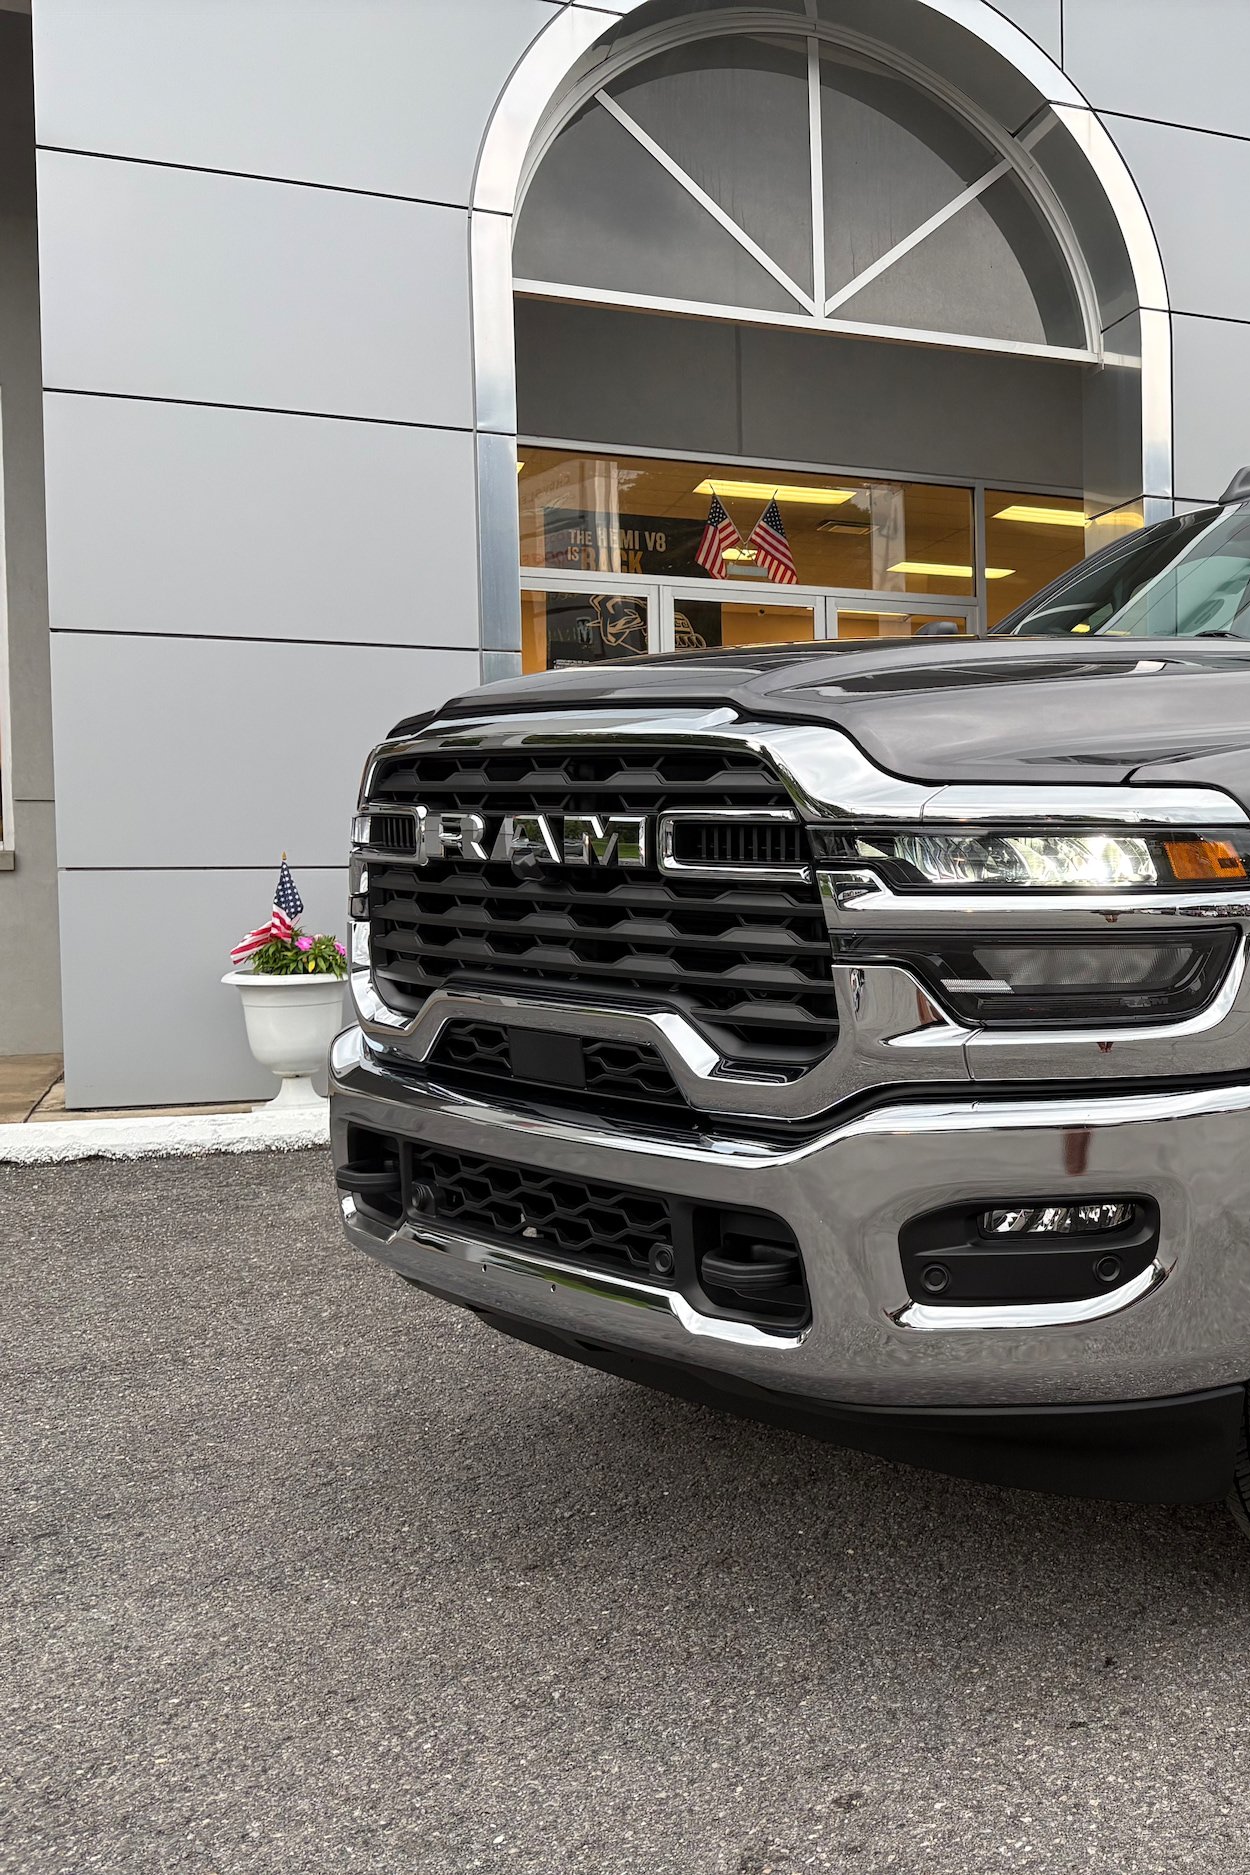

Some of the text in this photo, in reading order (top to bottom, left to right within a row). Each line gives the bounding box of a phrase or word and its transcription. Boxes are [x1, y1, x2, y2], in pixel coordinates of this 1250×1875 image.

[568, 529, 666, 552] THE HEMI V8
[567, 546, 579, 561] IS
[426, 813, 649, 868] RAM
